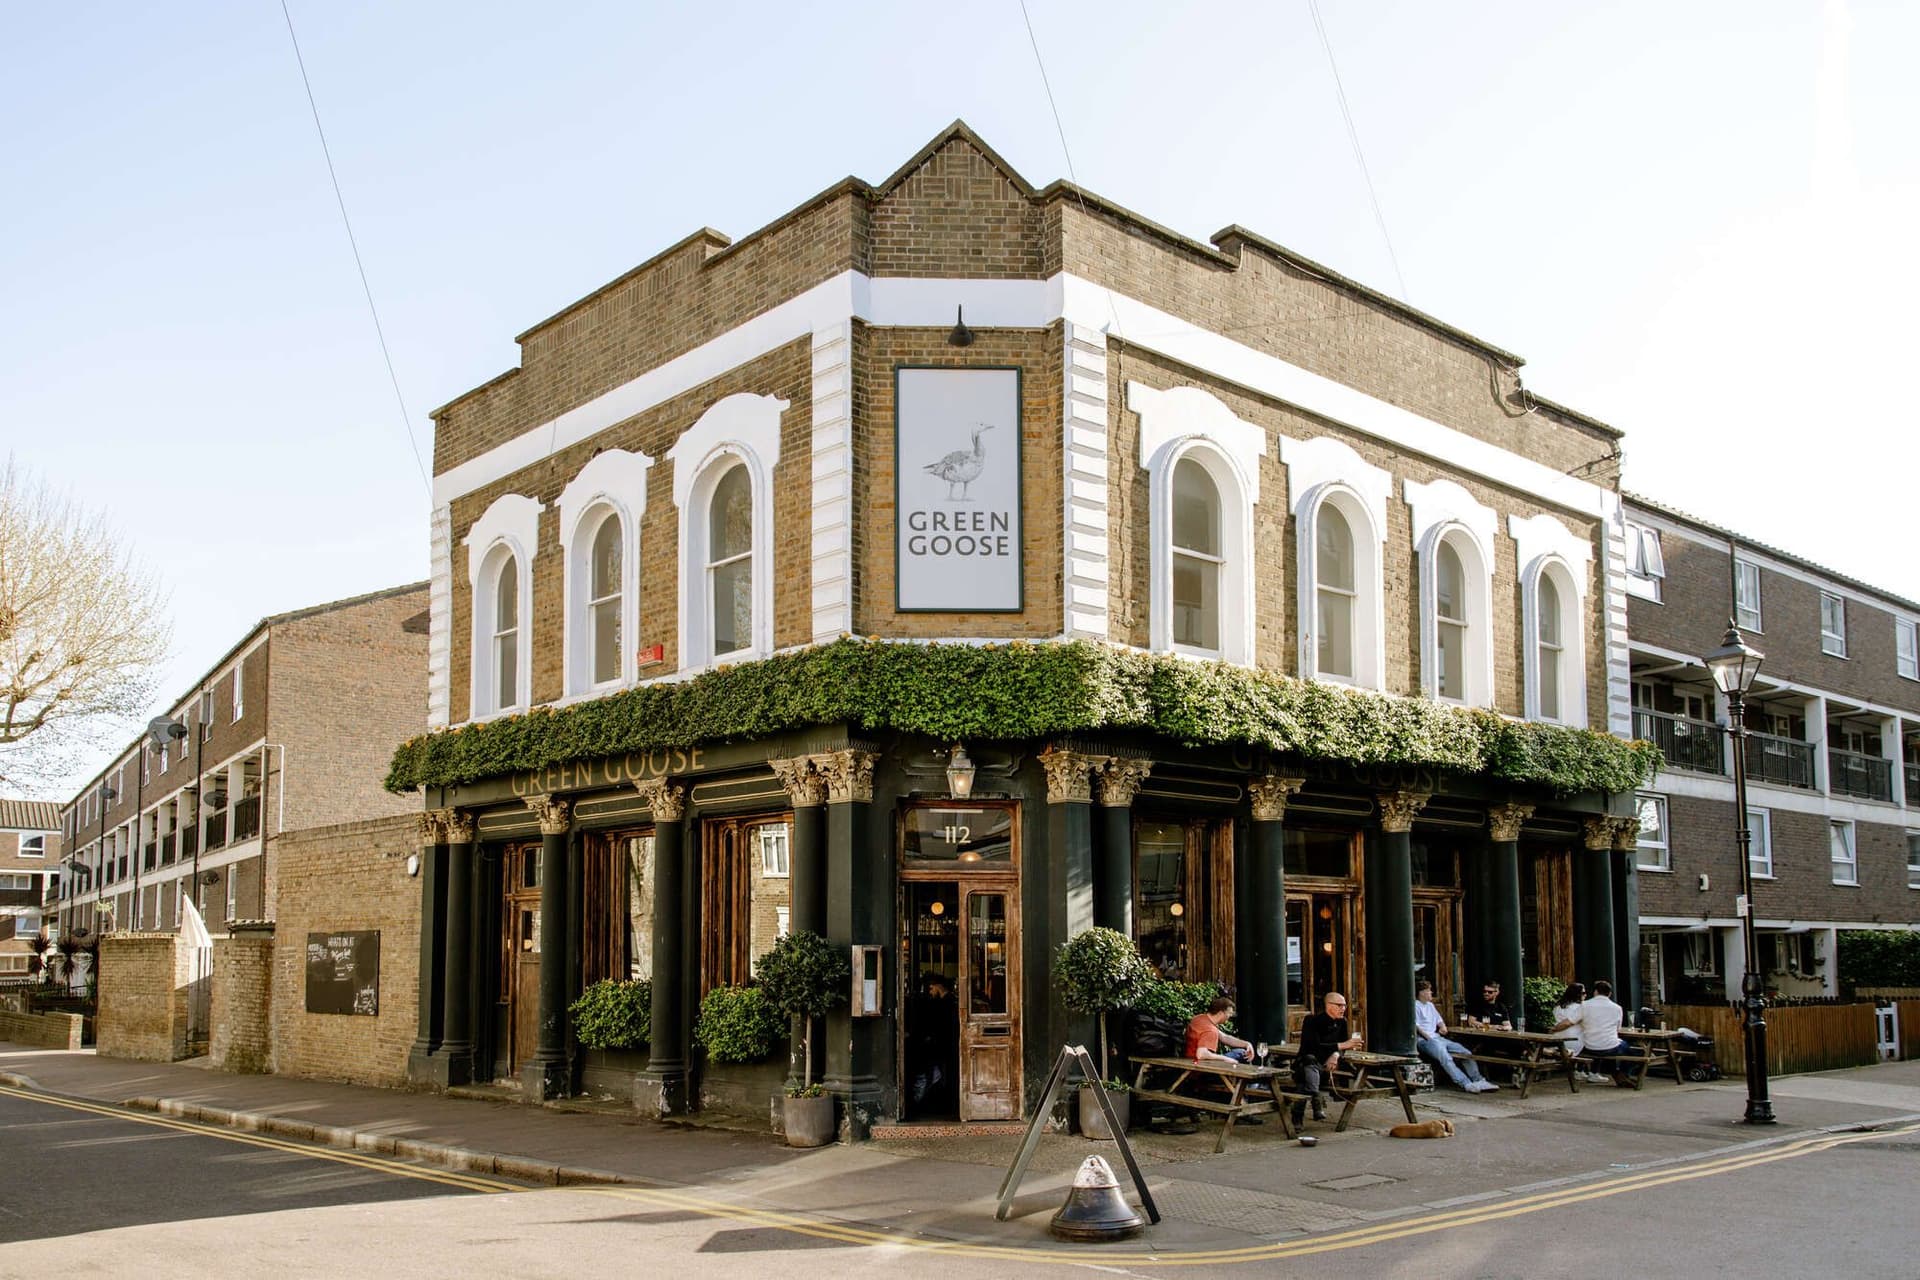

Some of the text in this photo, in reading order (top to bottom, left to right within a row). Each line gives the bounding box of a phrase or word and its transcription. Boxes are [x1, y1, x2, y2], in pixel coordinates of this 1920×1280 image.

[908, 511, 1009, 532] GREEN
[908, 535, 1010, 556] GOOSE
[604, 746, 705, 784] GOOSE
[945, 826, 972, 844] 112
